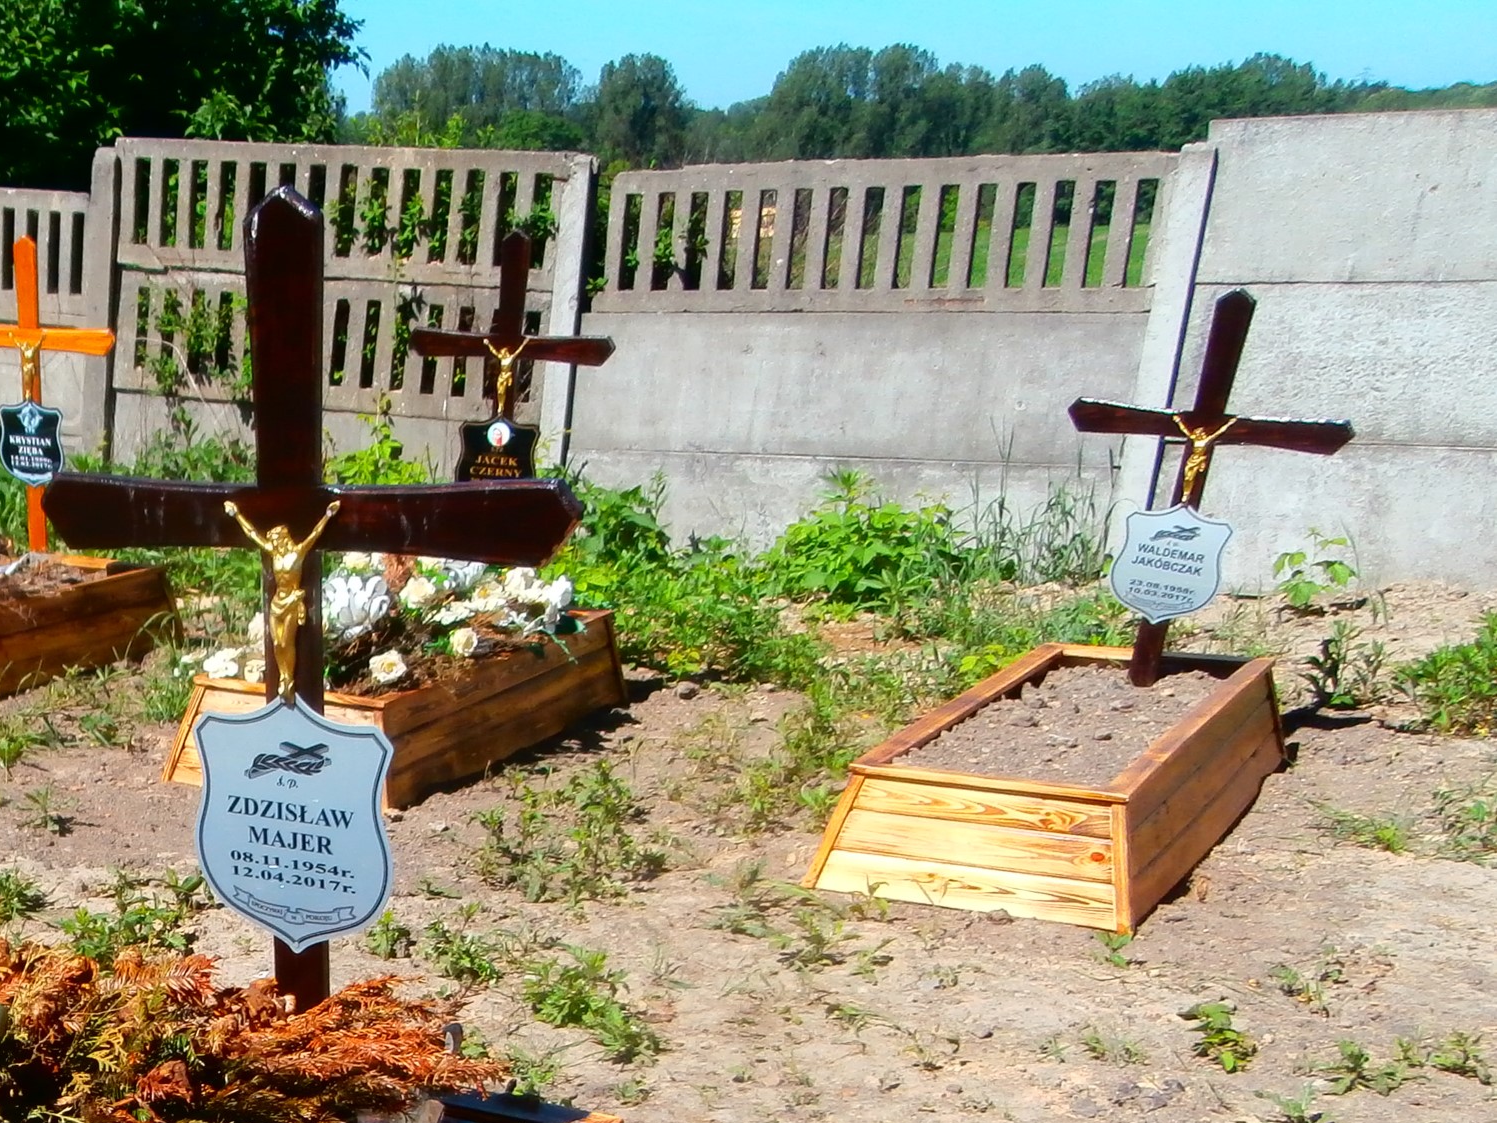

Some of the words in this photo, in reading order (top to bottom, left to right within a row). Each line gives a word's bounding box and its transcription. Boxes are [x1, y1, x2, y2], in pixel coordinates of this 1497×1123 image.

[9, 434, 52, 447] KRYSTIAN
[475, 455, 518, 466] JACEK
[469, 466, 522, 478] CZERNY
[1137, 543, 1205, 564] WALDEMAR
[1131, 555, 1203, 577] JAKÓBCZAK
[227, 794, 354, 830] ZDZISŁAW
[248, 825, 333, 856] MAJER
[230, 850, 355, 879] 08.11.1954r.
[232, 865, 356, 894] 12.04.2017r.
